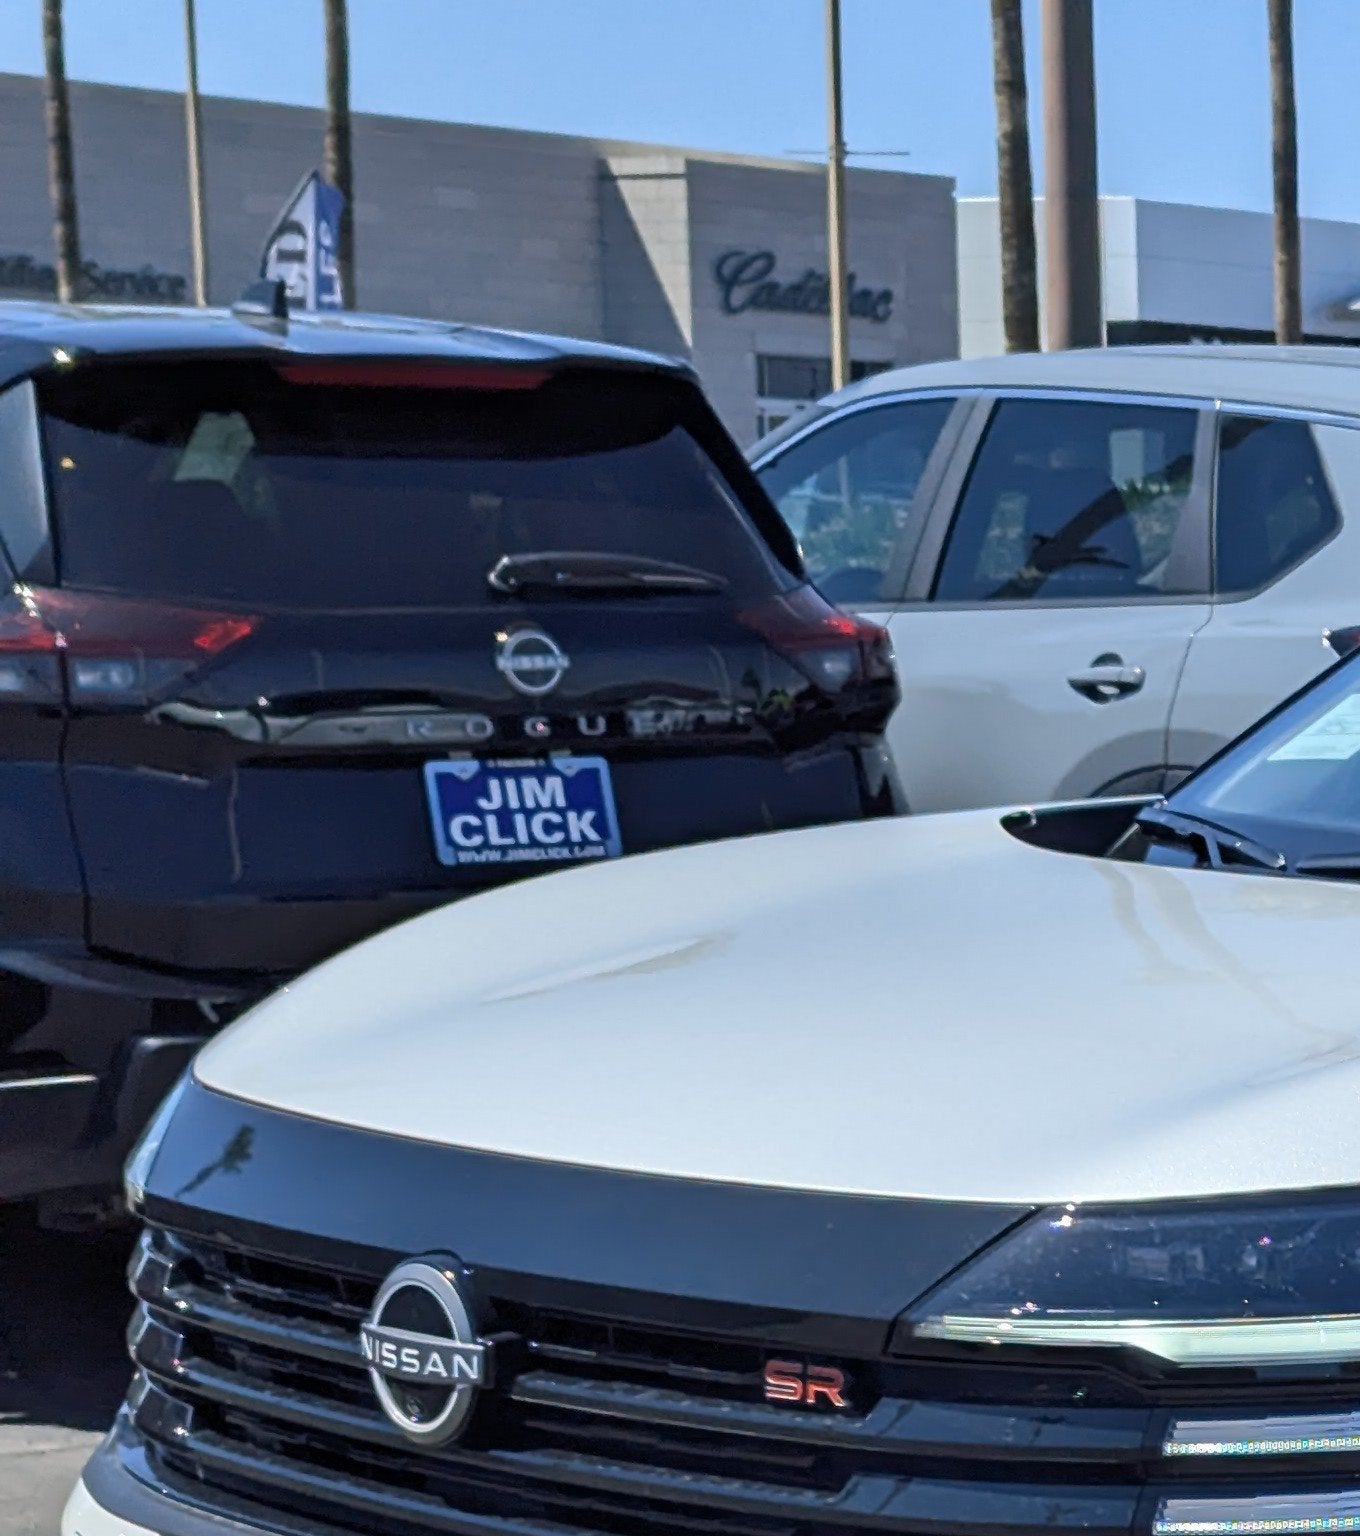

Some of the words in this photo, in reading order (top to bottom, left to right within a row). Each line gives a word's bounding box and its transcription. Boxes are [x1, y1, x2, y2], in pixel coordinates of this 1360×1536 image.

[406, 713, 656, 737] ROGUE
[476, 776, 567, 811] JIM
[450, 810, 602, 847] CLICK
[360, 1331, 479, 1380] NISSAN
[764, 1360, 847, 1408] SR
